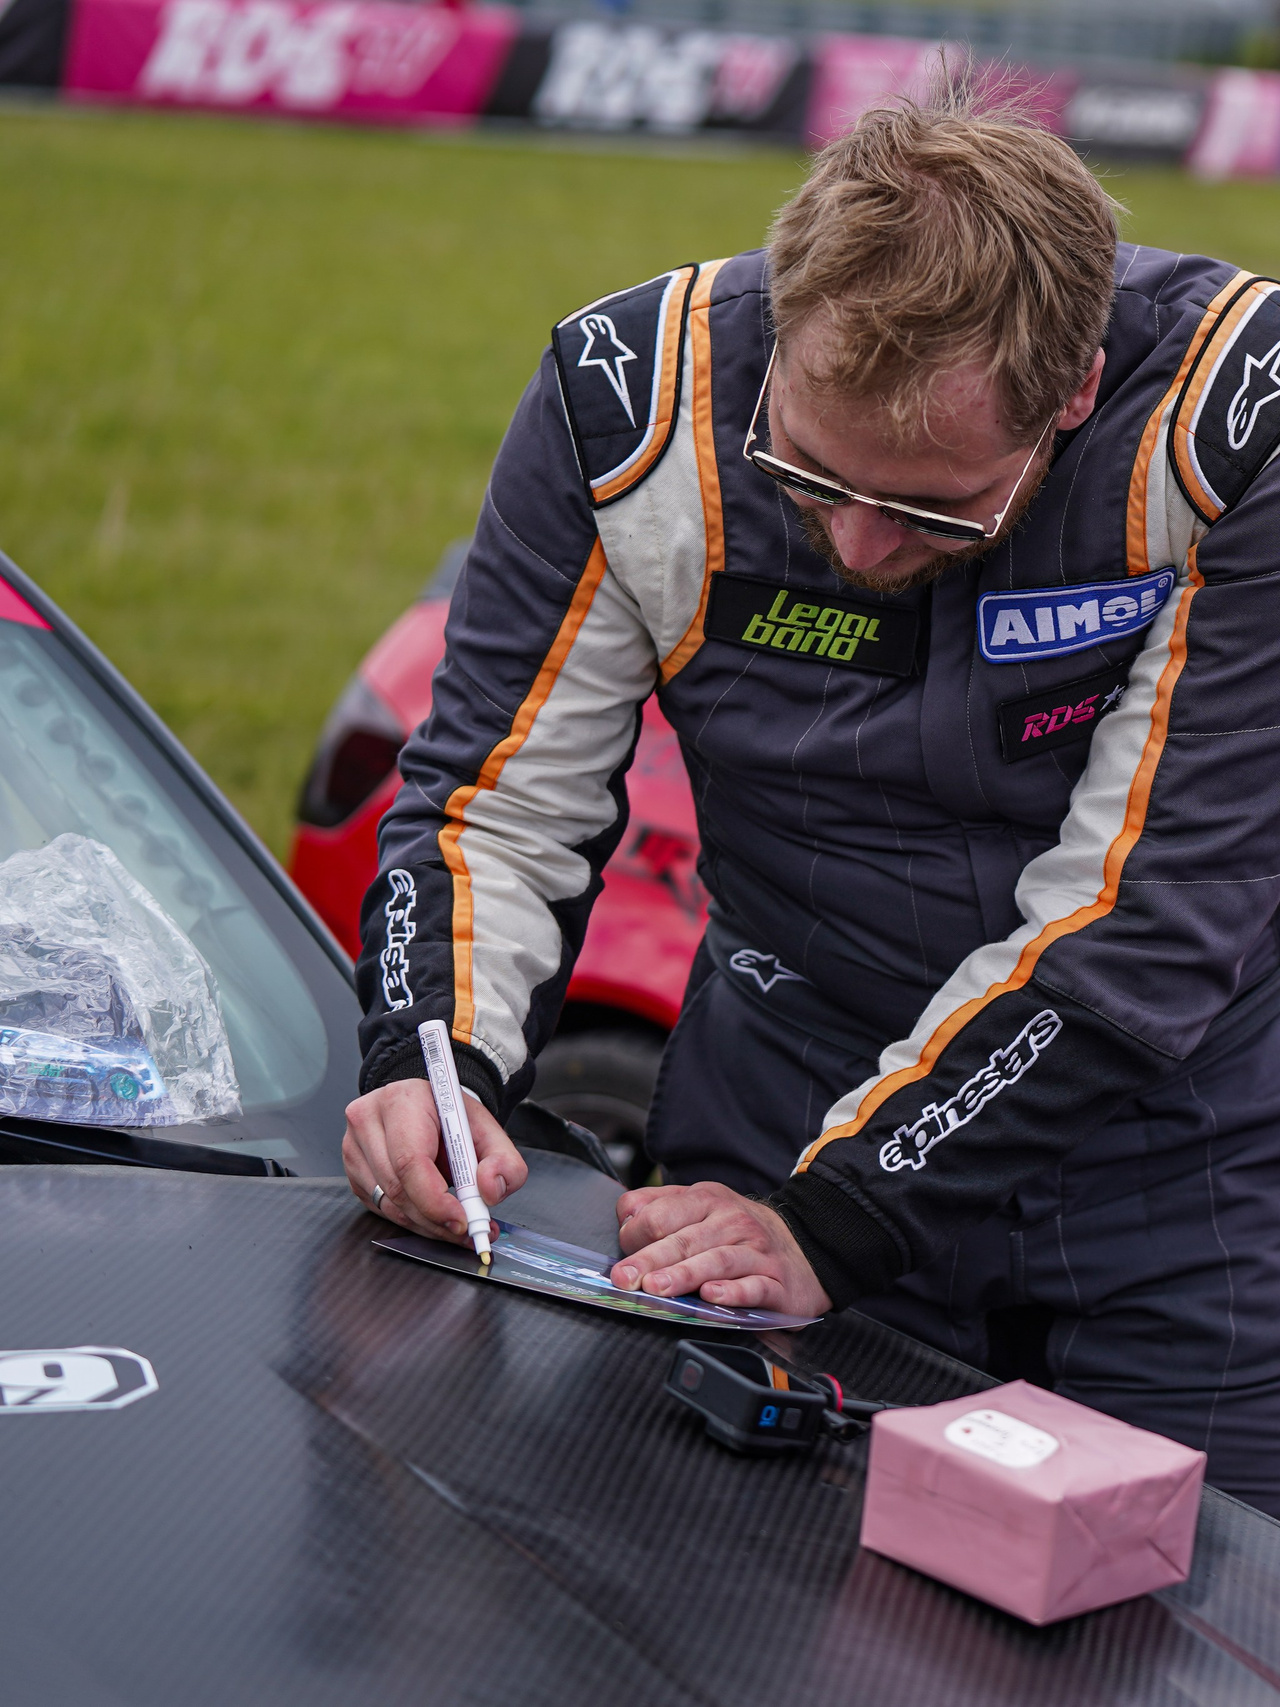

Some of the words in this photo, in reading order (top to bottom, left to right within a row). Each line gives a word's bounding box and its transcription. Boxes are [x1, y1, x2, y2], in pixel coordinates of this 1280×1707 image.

[766, 589, 880, 641] Legal
[990, 588, 1162, 646] AIMOL
[1021, 694, 1100, 742] RDS
